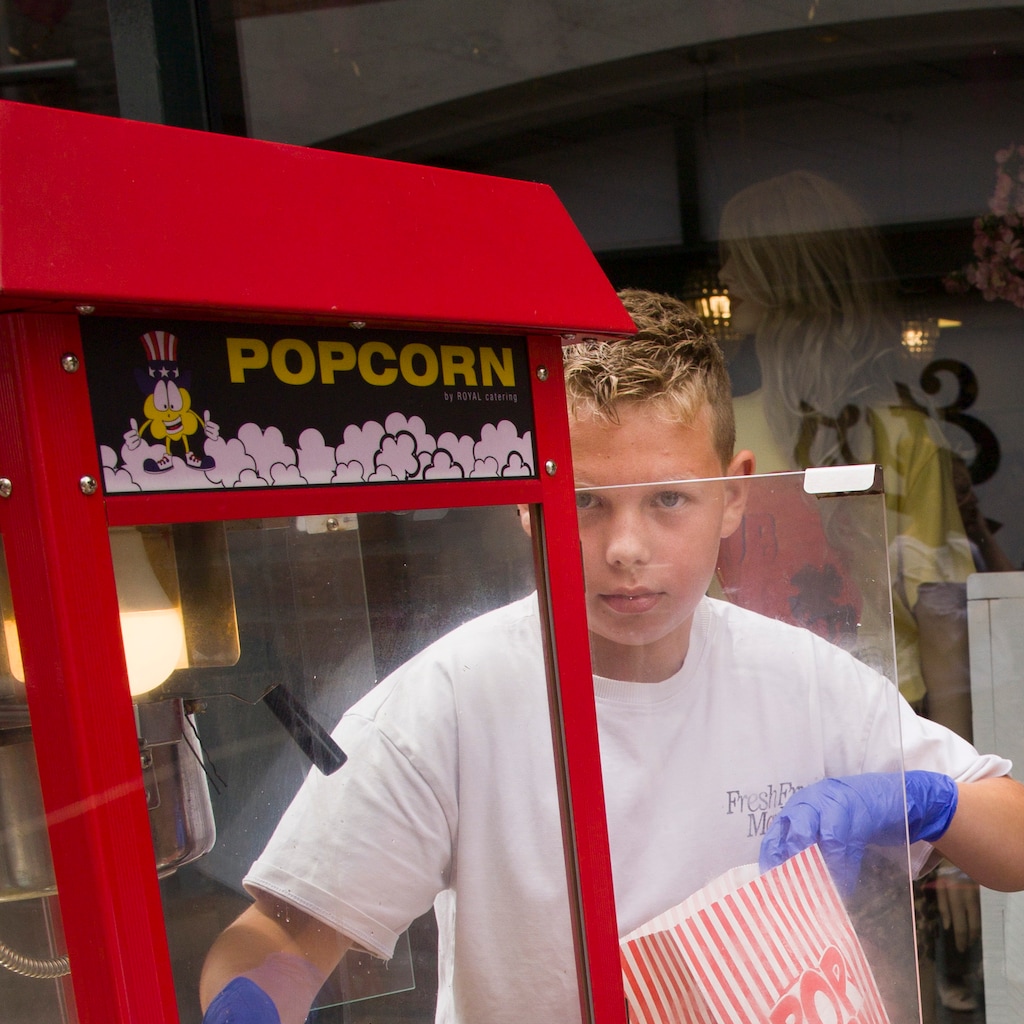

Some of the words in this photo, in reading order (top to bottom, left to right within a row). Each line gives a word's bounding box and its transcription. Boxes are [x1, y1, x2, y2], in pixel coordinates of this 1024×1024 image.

[225, 337, 516, 388] POPCORN
[444, 391, 454, 403] by
[457, 391, 482, 401] ROYAL
[485, 392, 518, 403] catering
